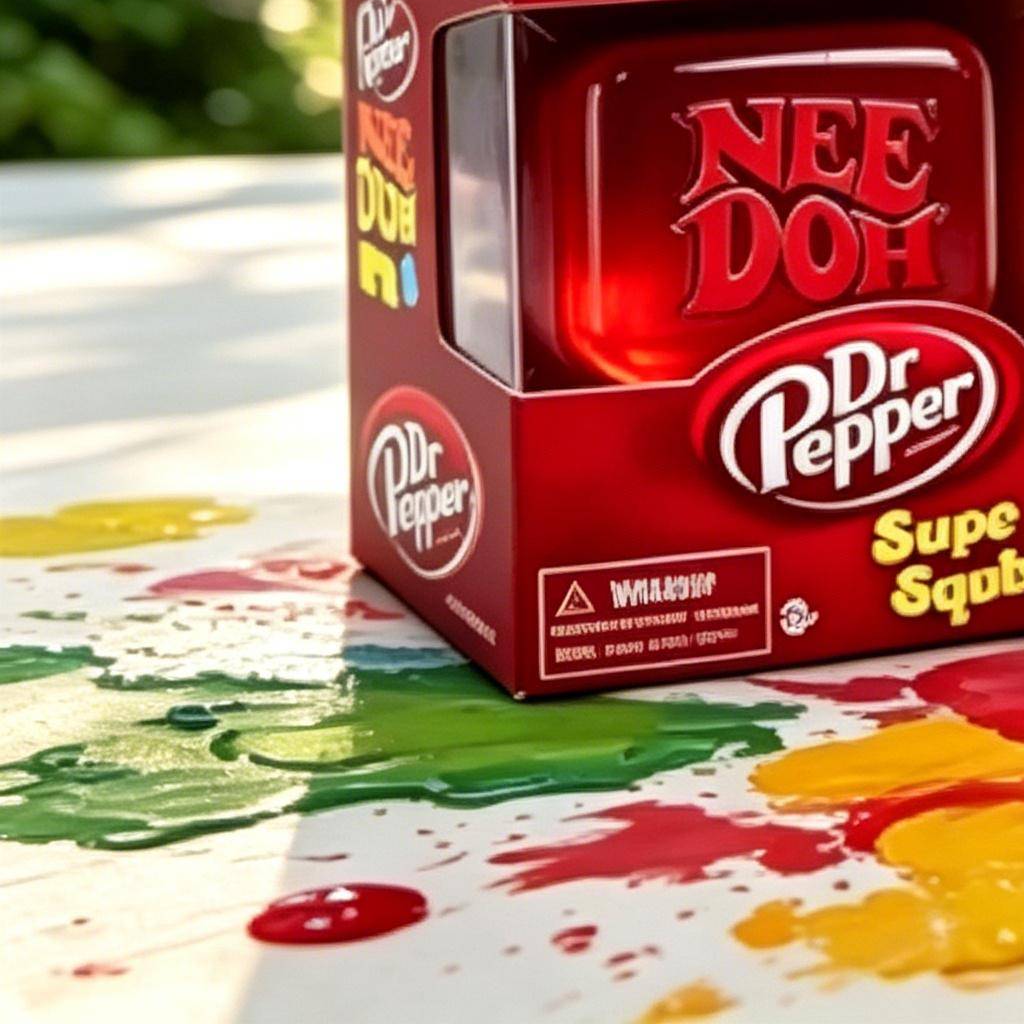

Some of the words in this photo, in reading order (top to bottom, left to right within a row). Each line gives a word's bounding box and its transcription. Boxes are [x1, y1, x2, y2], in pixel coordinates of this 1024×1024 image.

[679, 97, 938, 215] NEE
[673, 187, 949, 316] DOH
[758, 363, 975, 494] Pepper
[824, 339, 920, 418] Dr
[383, 424, 470, 554] Pepper
[403, 421, 444, 485] Dr
[872, 501, 1020, 566] Supe
